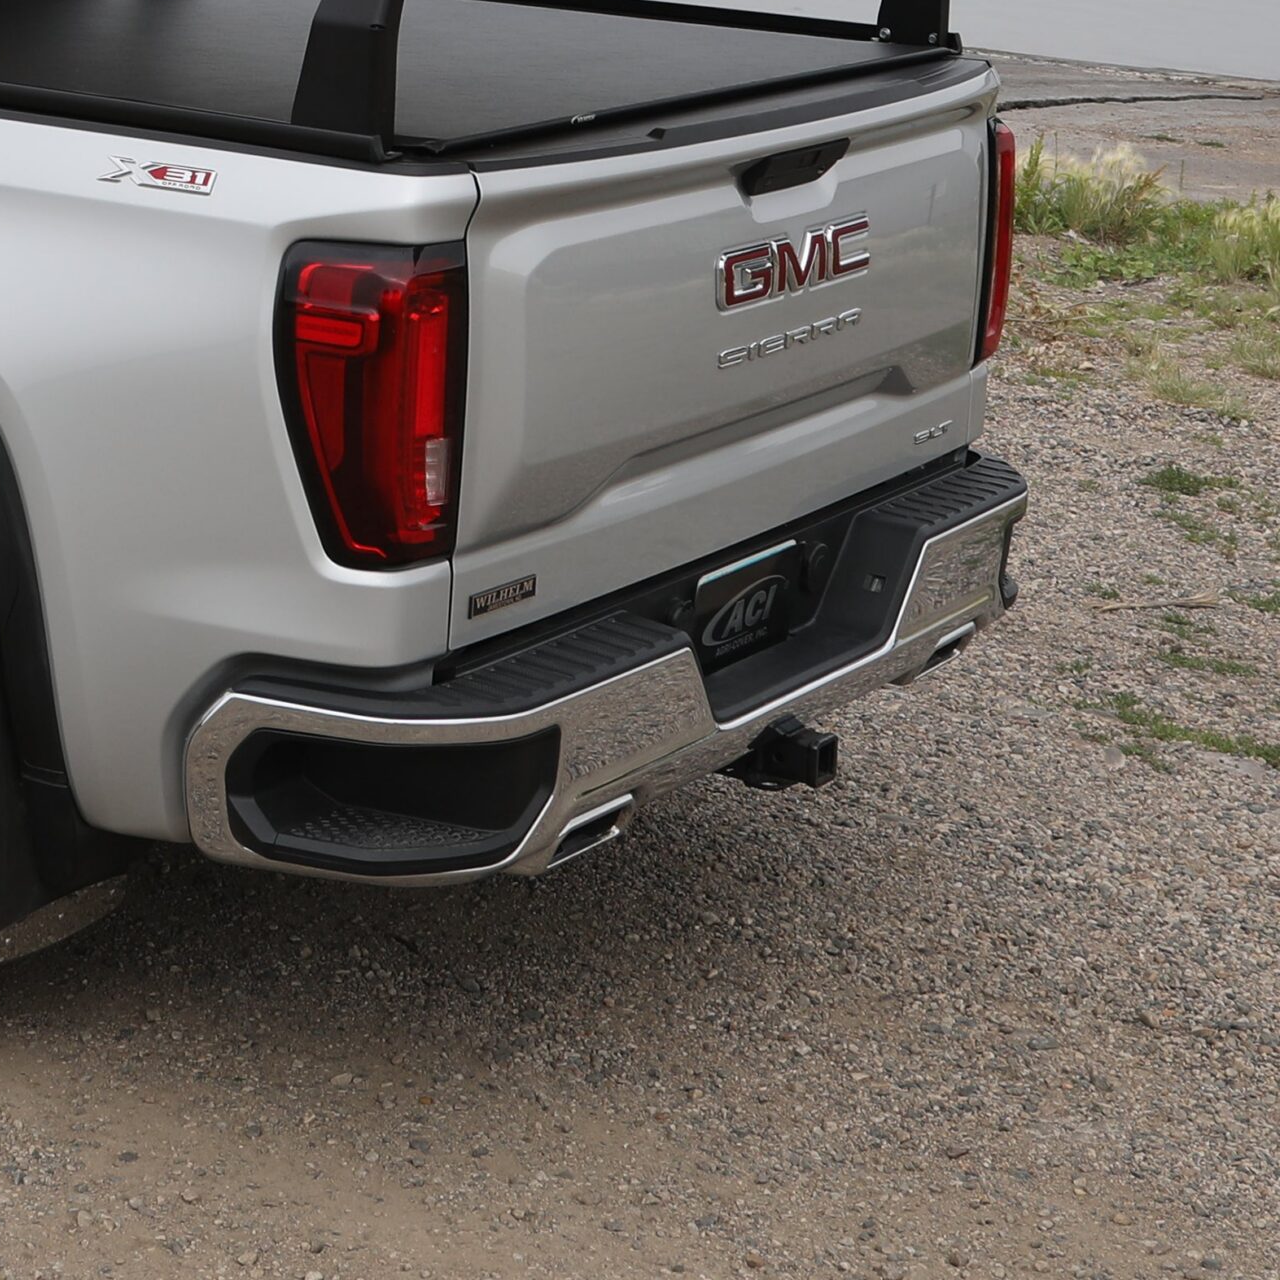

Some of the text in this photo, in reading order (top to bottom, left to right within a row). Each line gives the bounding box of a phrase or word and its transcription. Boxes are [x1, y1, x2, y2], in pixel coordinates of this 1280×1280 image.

[97, 155, 214, 188] X31
[717, 214, 871, 312] GMC
[718, 307, 862, 369] SIERRA
[914, 419, 953, 445] SLT
[475, 579, 534, 609] WILHELM
[721, 583, 778, 639] ACI
